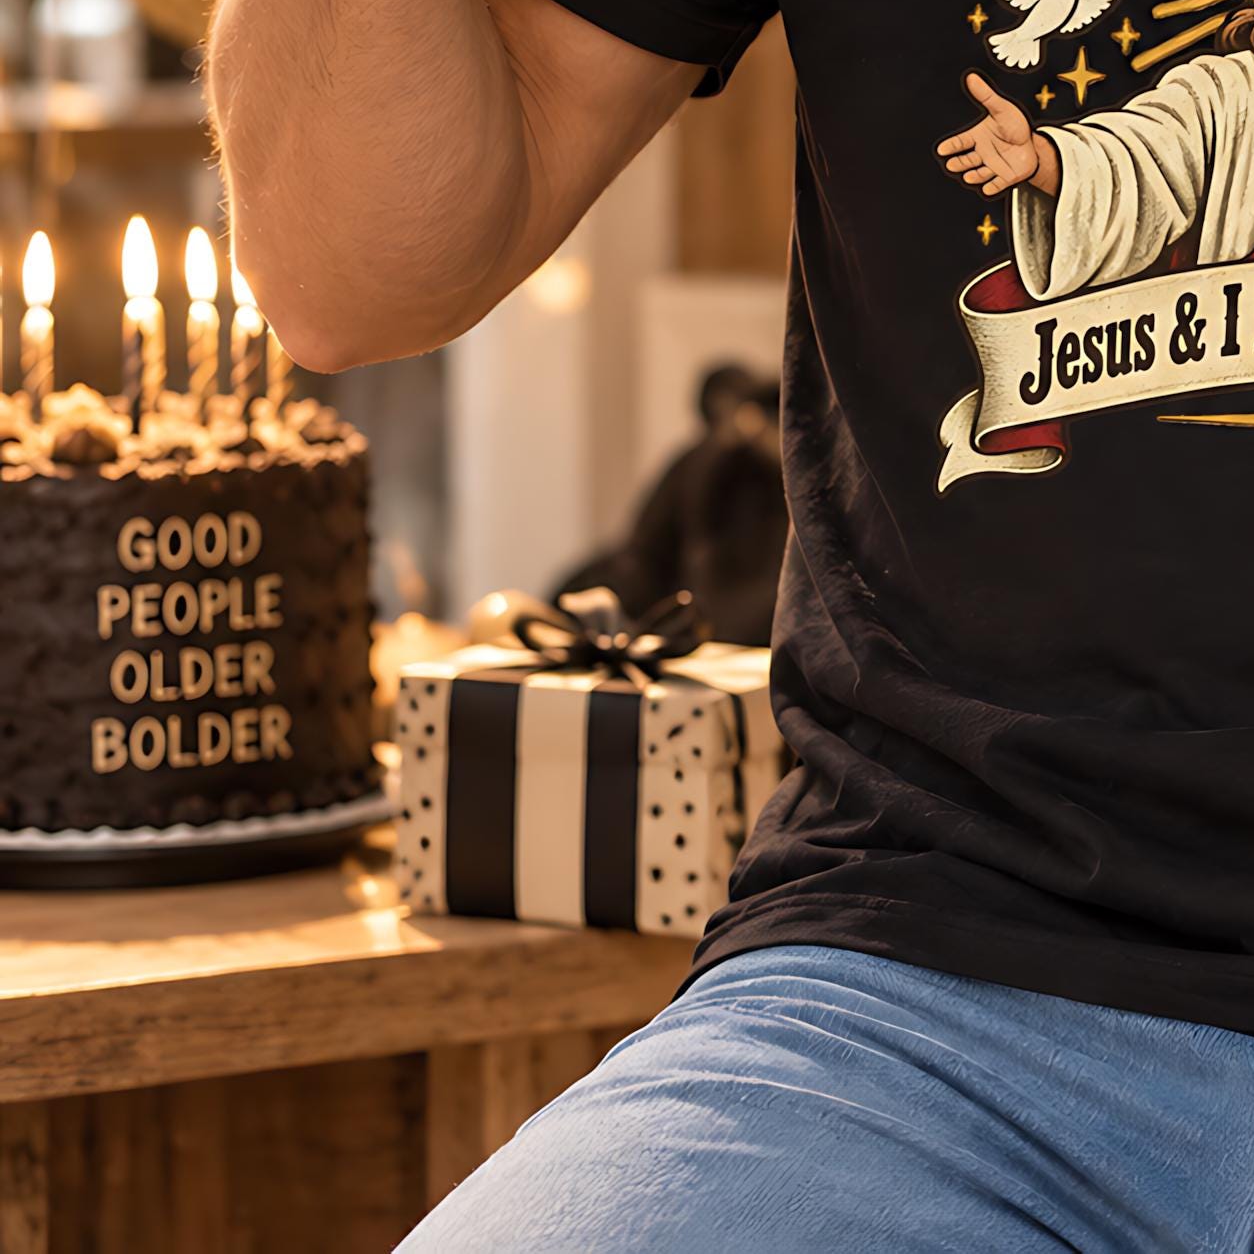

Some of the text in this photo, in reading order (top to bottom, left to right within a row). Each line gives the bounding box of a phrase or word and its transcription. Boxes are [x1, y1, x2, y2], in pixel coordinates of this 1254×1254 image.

[1019, 316, 1156, 405] Jesus
[1169, 291, 1207, 365] &
[1221, 282, 1242, 357] I
[117, 511, 261, 572] GOOD
[98, 573, 283, 640] PEOPLE
[109, 642, 276, 704] OLDER
[91, 704, 293, 774] BOLDER
